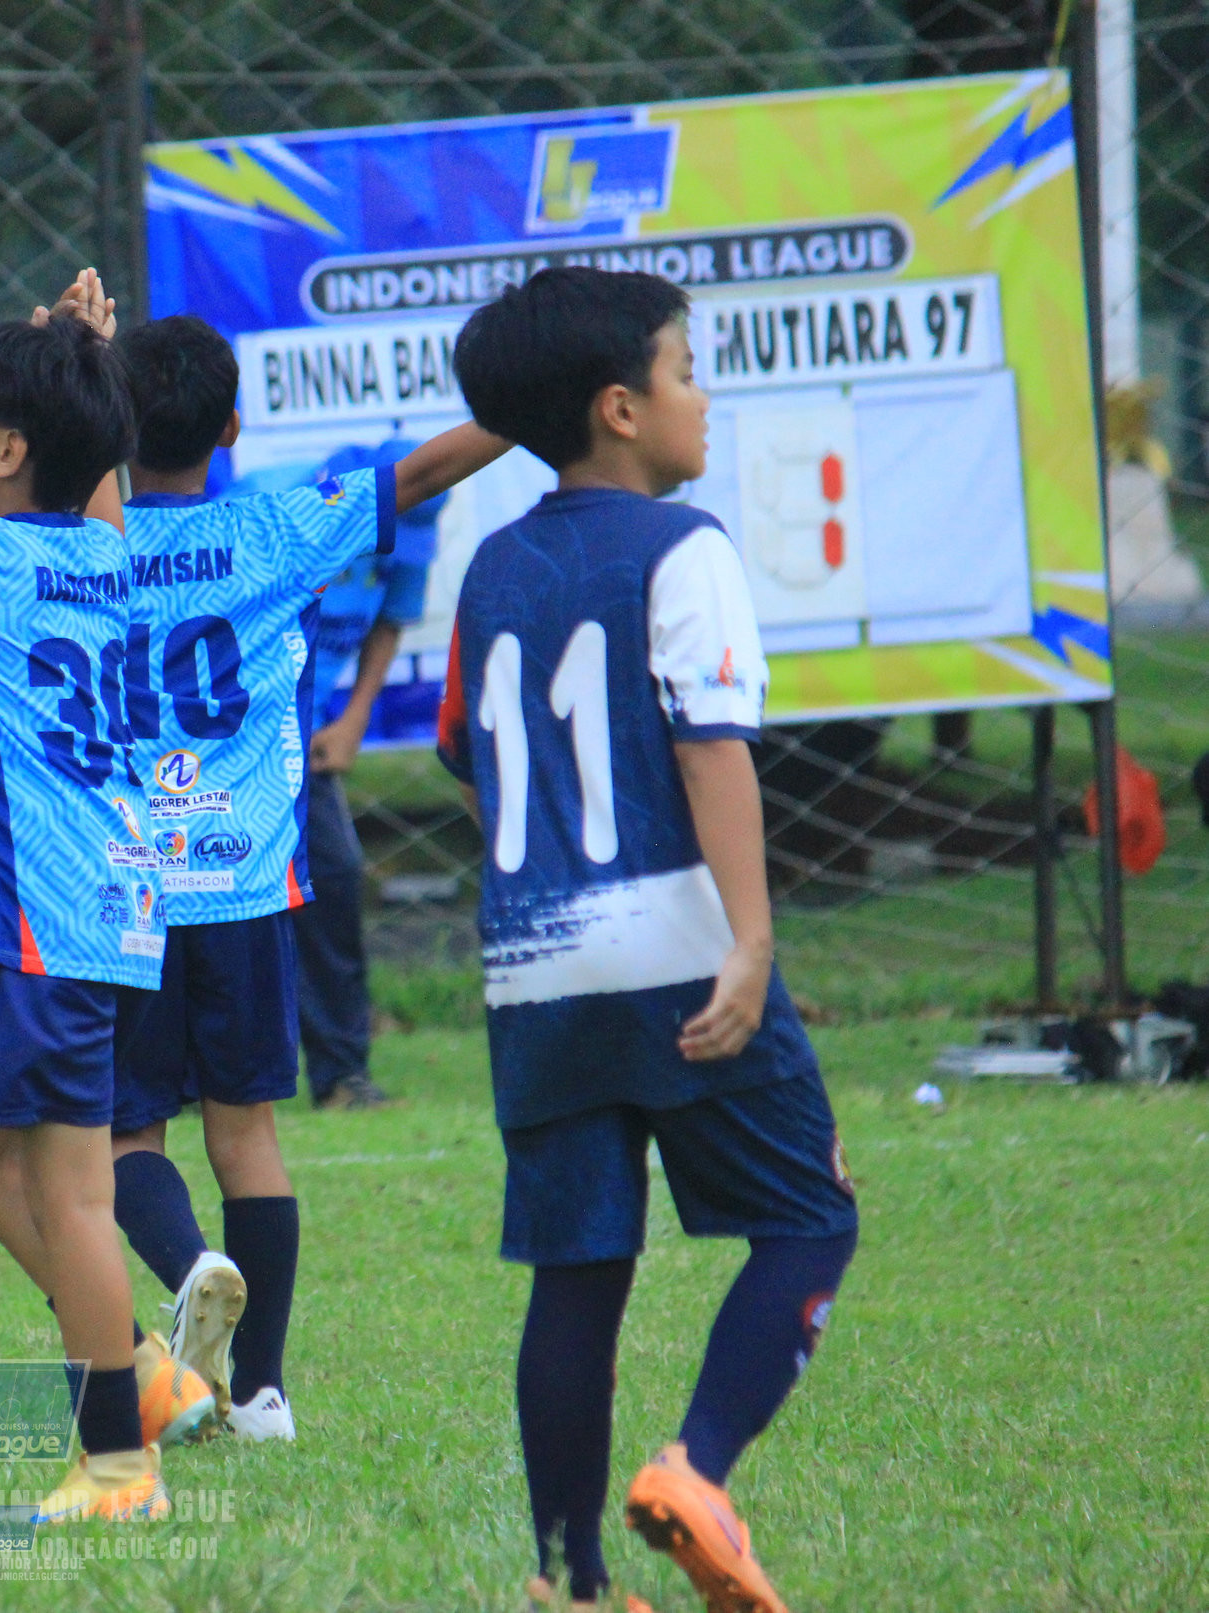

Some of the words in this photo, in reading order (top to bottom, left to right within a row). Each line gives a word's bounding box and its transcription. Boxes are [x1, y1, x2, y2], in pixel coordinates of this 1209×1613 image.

[323, 256, 552, 313] INDONESI
[727, 228, 893, 278] LEAGUE
[265, 340, 385, 412] BINNA
[715, 297, 911, 378] MUTIARA
[924, 293, 976, 359] 97
[478, 620, 619, 873] 11
